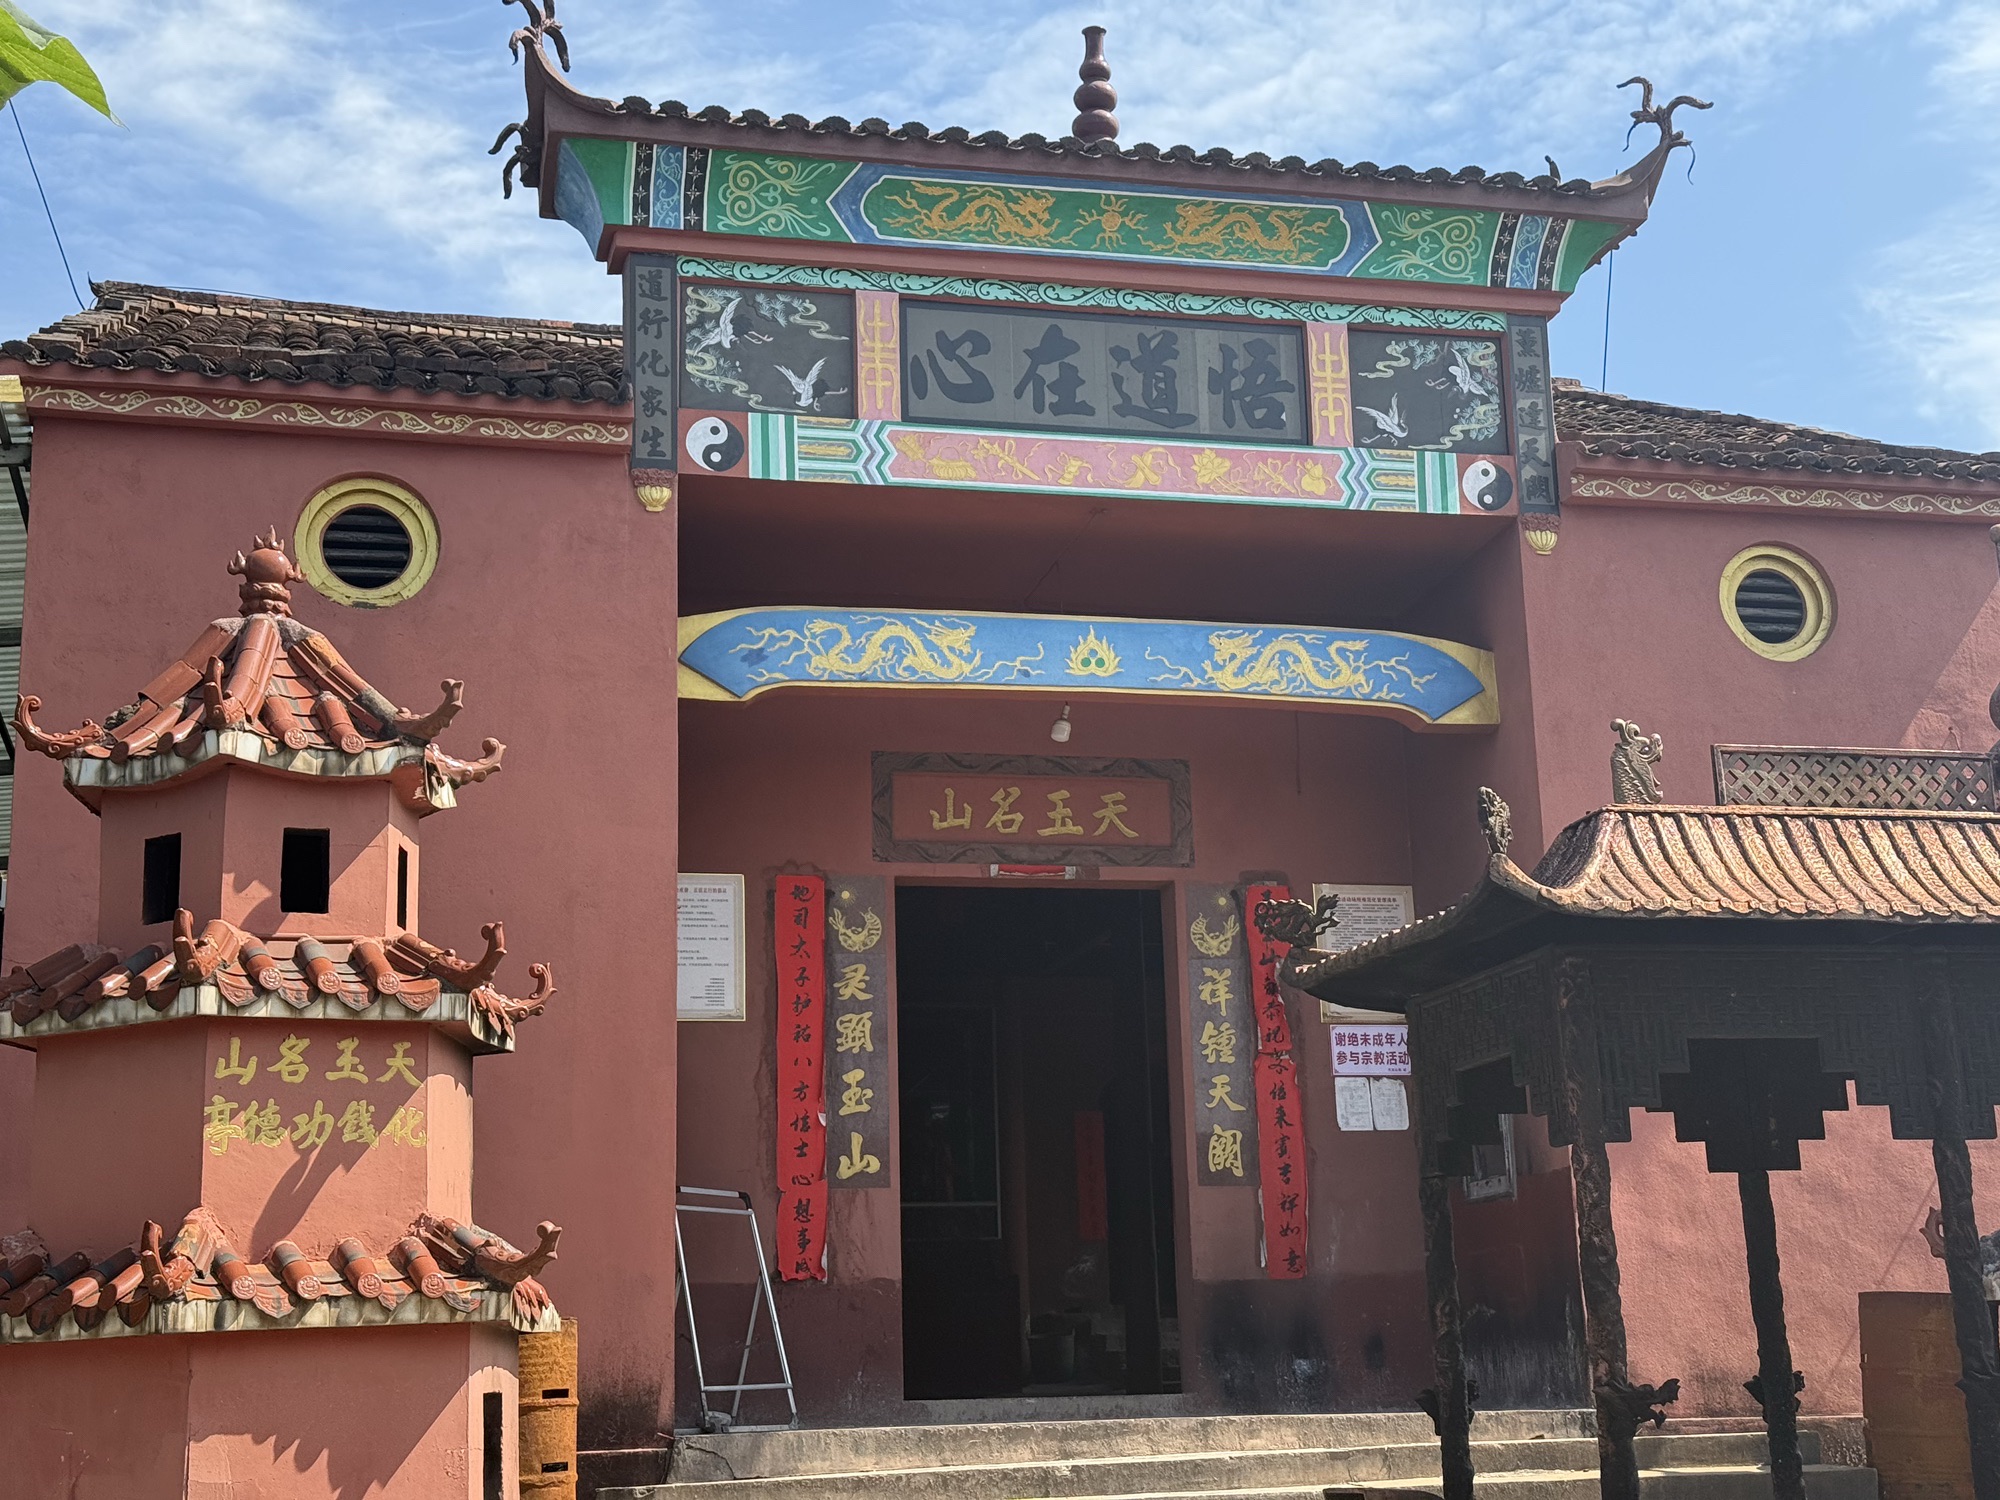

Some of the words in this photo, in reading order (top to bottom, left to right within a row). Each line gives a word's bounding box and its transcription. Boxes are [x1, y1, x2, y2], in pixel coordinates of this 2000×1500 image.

[910, 324, 1296, 430] 悟道在心
[1335, 1032, 1408, 1047] 谢绝未成年人
[214, 1034, 425, 1088] 天玉名山
[1336, 1051, 1410, 1066] 参与宗教活动
